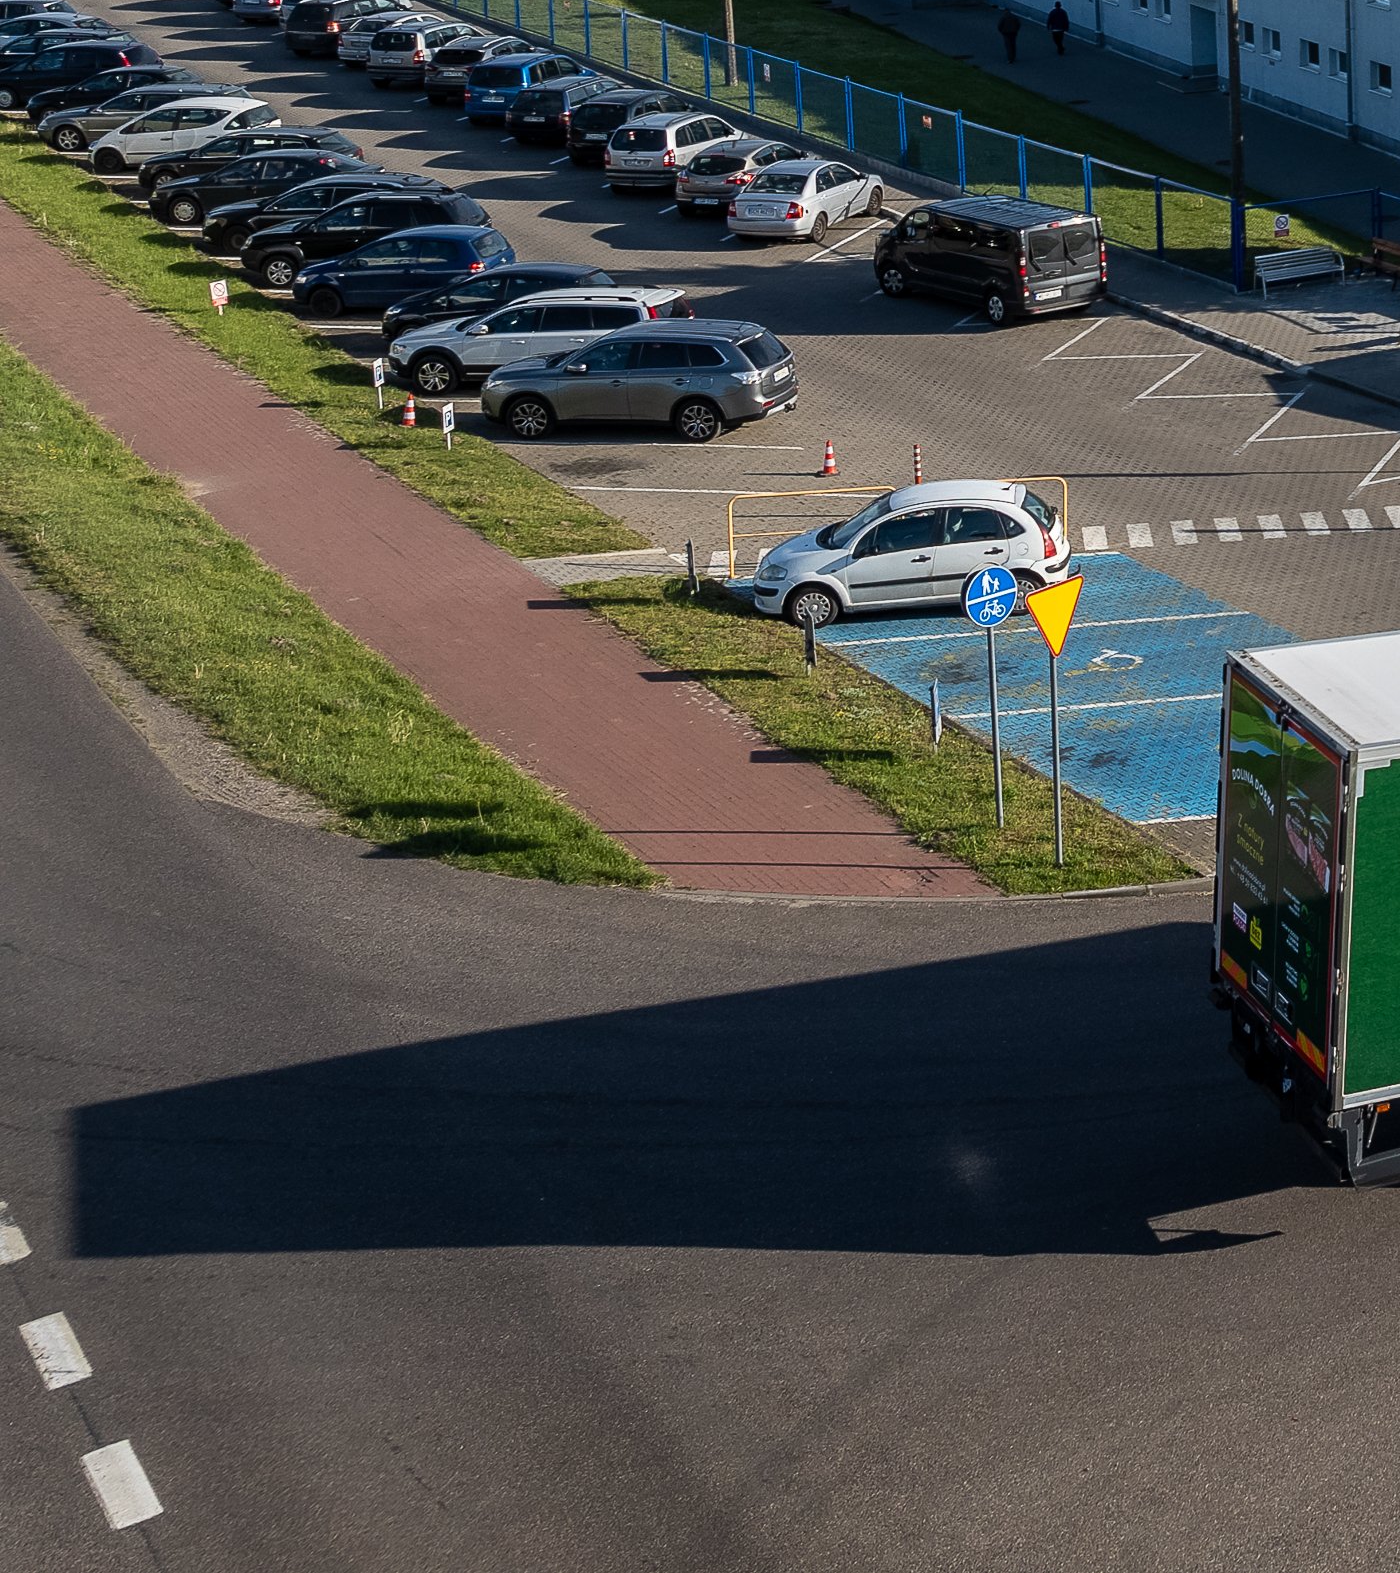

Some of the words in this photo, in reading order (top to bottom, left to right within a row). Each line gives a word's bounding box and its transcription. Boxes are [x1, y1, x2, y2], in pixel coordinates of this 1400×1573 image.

[1231, 767, 1255, 787] DOLINA
[1254, 779, 1275, 817] DOBRA
[1237, 812, 1243, 828] Z
[1236, 833, 1265, 866] smaczne
